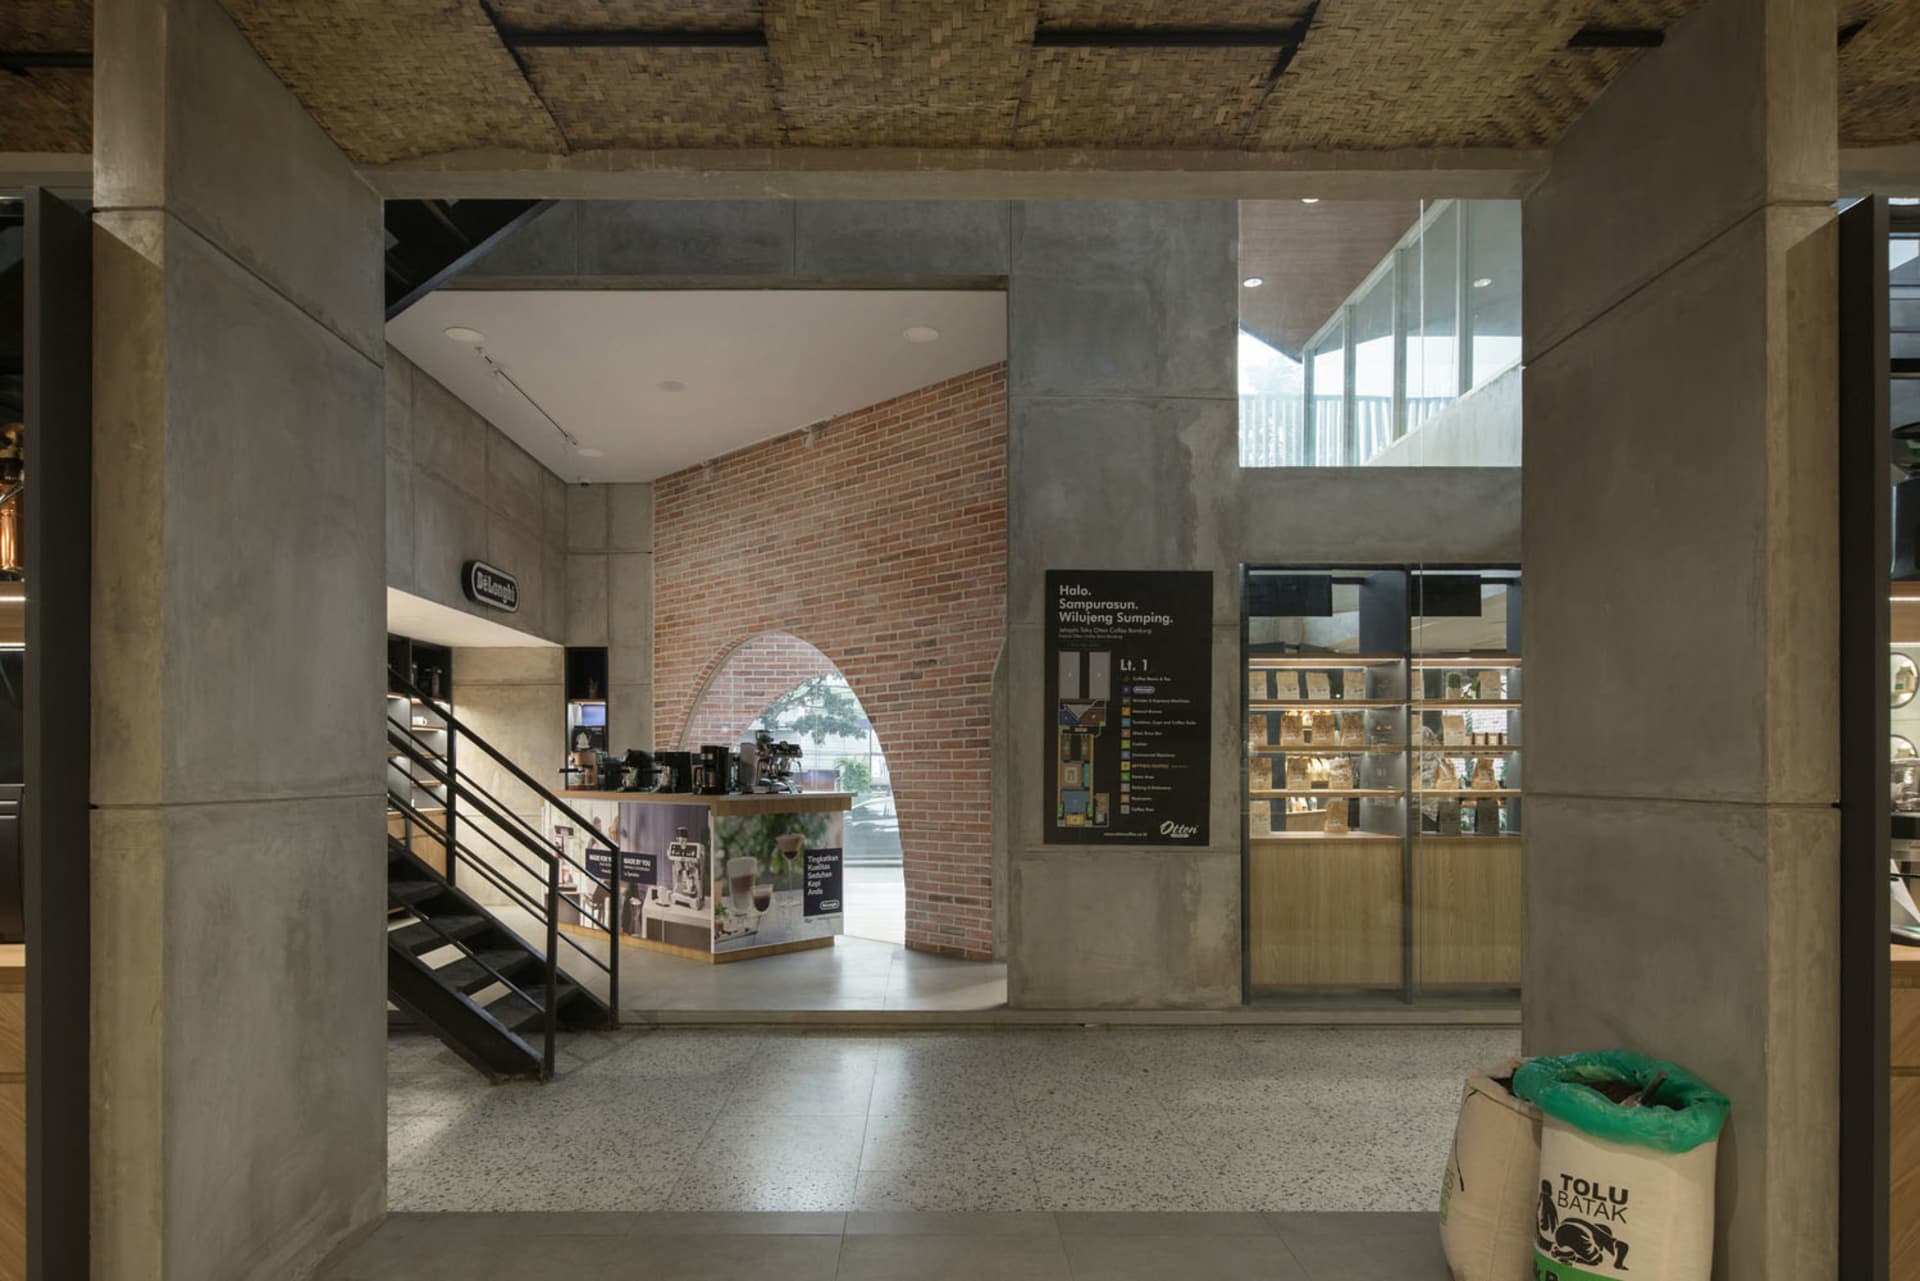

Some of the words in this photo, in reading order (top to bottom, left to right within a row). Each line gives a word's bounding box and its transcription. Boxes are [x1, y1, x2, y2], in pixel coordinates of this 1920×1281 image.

[1059, 585, 1092, 596] Halo.
[1059, 598, 1139, 611] Sampurasun.
[1059, 612, 1113, 625] Wilujeng
[1116, 612, 1174, 625] Sumping.
[1120, 659, 1136, 671] Lt.
[1141, 659, 1148, 671] 1
[1160, 820, 1199, 835] Otten
[807, 855, 839, 864] Tingkatkan
[807, 871, 833, 879] Seduhan
[807, 880, 822, 888] Kopi
[807, 888, 824, 896] Anda
[1560, 1174, 1629, 1205] TOLU
[1557, 1191, 1628, 1224] BATAK
